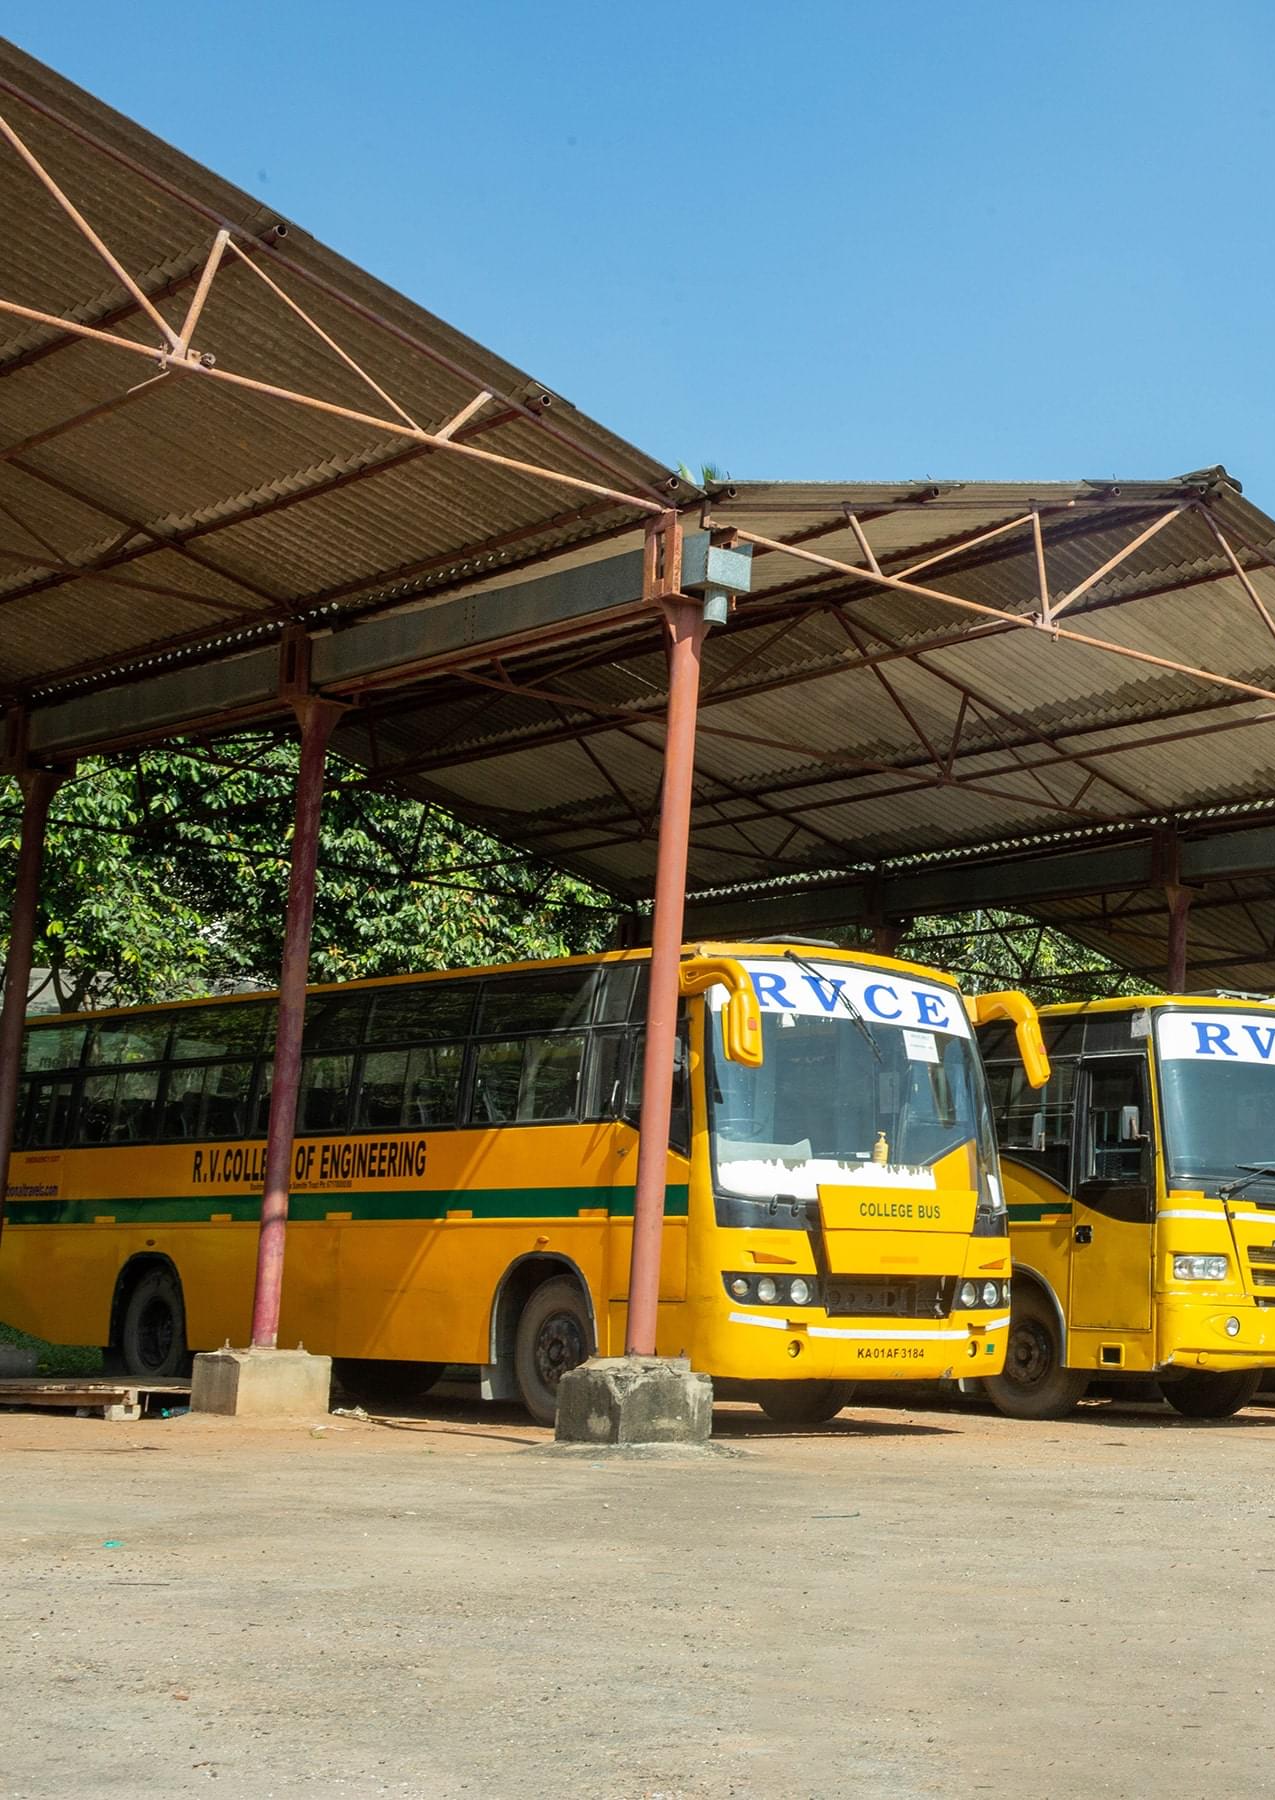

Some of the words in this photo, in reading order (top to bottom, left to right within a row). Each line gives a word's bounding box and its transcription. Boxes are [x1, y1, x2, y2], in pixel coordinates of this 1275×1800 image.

[748, 971, 950, 1028] RVCE
[192, 1147, 268, 1183] R.V.COLLE
[295, 1145, 316, 1180] OF
[319, 1140, 427, 1179] ENGINEERING
[860, 1202, 913, 1218] COLLEGE
[918, 1205, 941, 1219] BUS
